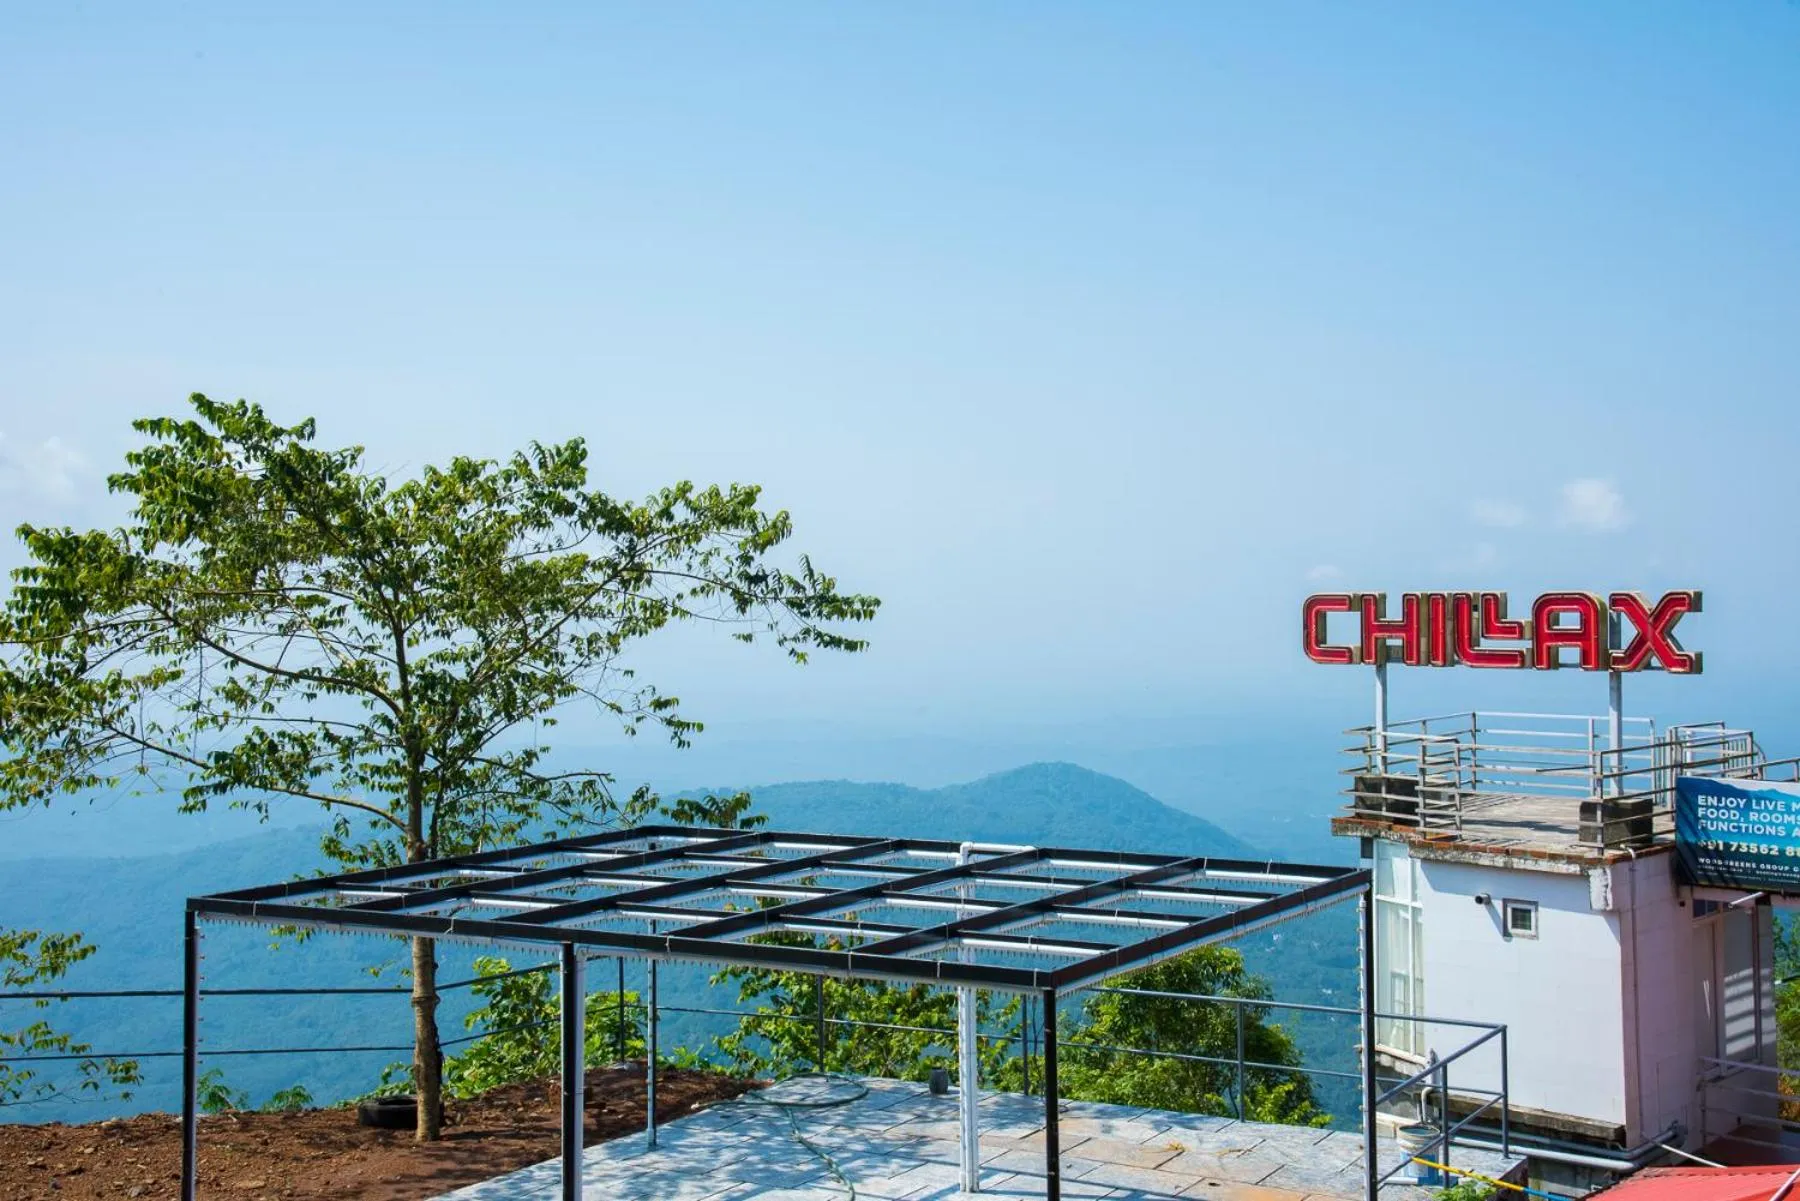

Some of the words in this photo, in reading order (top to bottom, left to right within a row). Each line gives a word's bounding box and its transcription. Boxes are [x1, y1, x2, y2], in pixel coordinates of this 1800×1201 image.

[1303, 592, 1702, 673] CHILLAX
[1697, 795, 1747, 808] ENJOY
[1752, 799, 1786, 811] LIVE
[1697, 807, 1744, 822] FOOD,
[1698, 819, 1786, 836] FUNCTIONS
[1730, 841, 1779, 855] 73562
